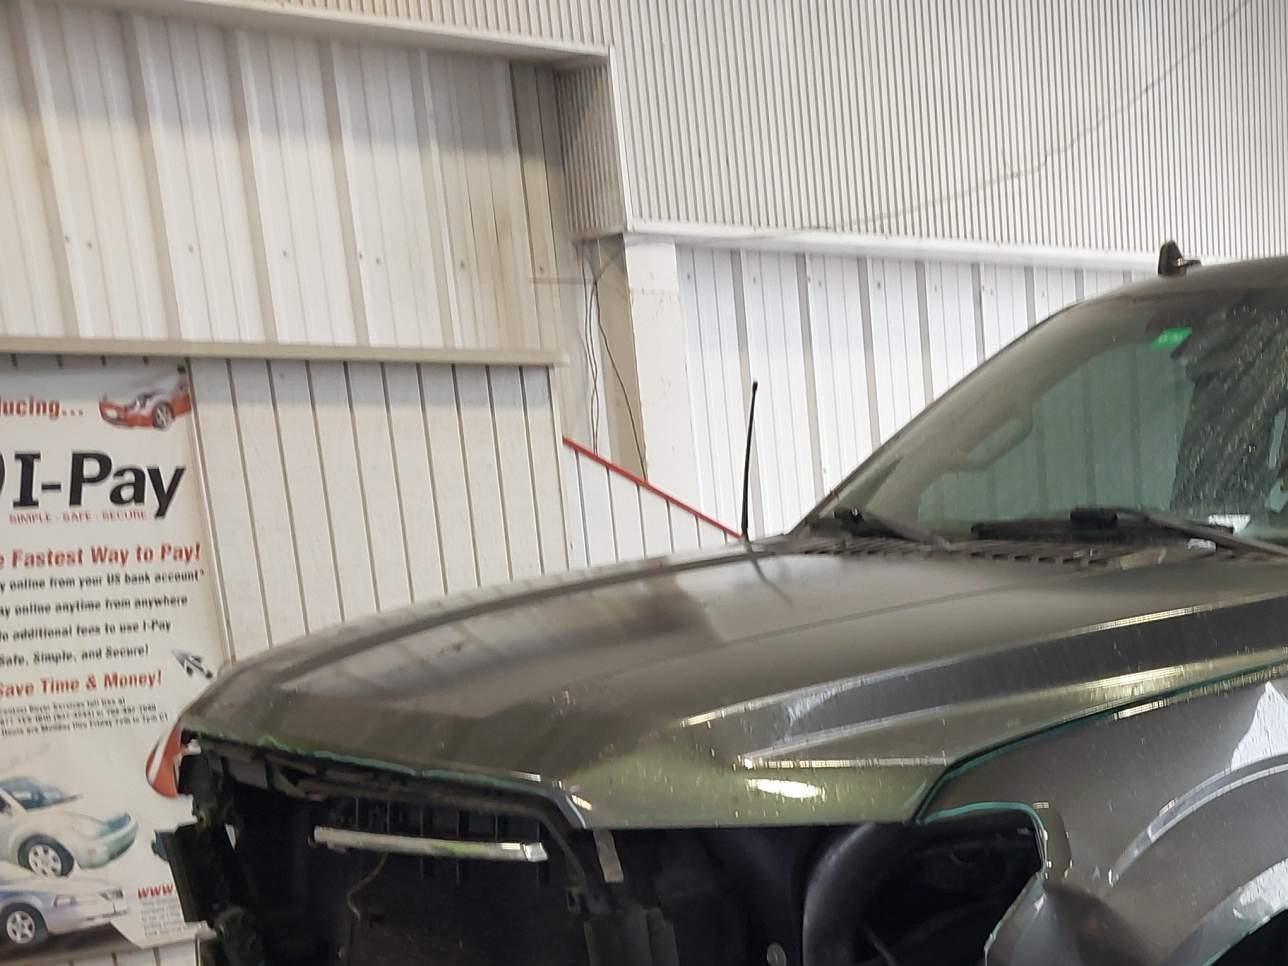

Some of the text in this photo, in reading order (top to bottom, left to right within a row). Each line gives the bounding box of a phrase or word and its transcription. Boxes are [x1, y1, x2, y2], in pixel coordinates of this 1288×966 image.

[0, 394, 85, 421] ucing...
[13, 450, 187, 519] I-Pay
[9, 510, 147, 525] SIMPLE SAFE SECURE
[12, 548, 84, 569] Fastest
[91, 544, 130, 567] Way
[136, 544, 154, 562] to
[160, 542, 201, 565] Pay!
[10, 577, 46, 591] online
[50, 576, 76, 589] from
[79, 575, 103, 589] your
[107, 573, 121, 585] US
[125, 571, 151, 585] bank
[15, 602, 51, 616] online
[55, 599, 101, 615] anytime
[105, 598, 131, 611] from
[134, 594, 188, 611] anywhere
[13, 625, 72, 641] additional
[77, 624, 101, 637] fees
[105, 622, 117, 634] to
[120, 623, 139, 633] use
[142, 619, 172, 633] I-Pay
[33, 650, 77, 667] Simple,
[82, 647, 102, 661] and
[106, 643, 149, 659] Secure!
[40, 676, 80, 696] Time
[86, 673, 97, 691] &
[103, 669, 163, 692] Money!
